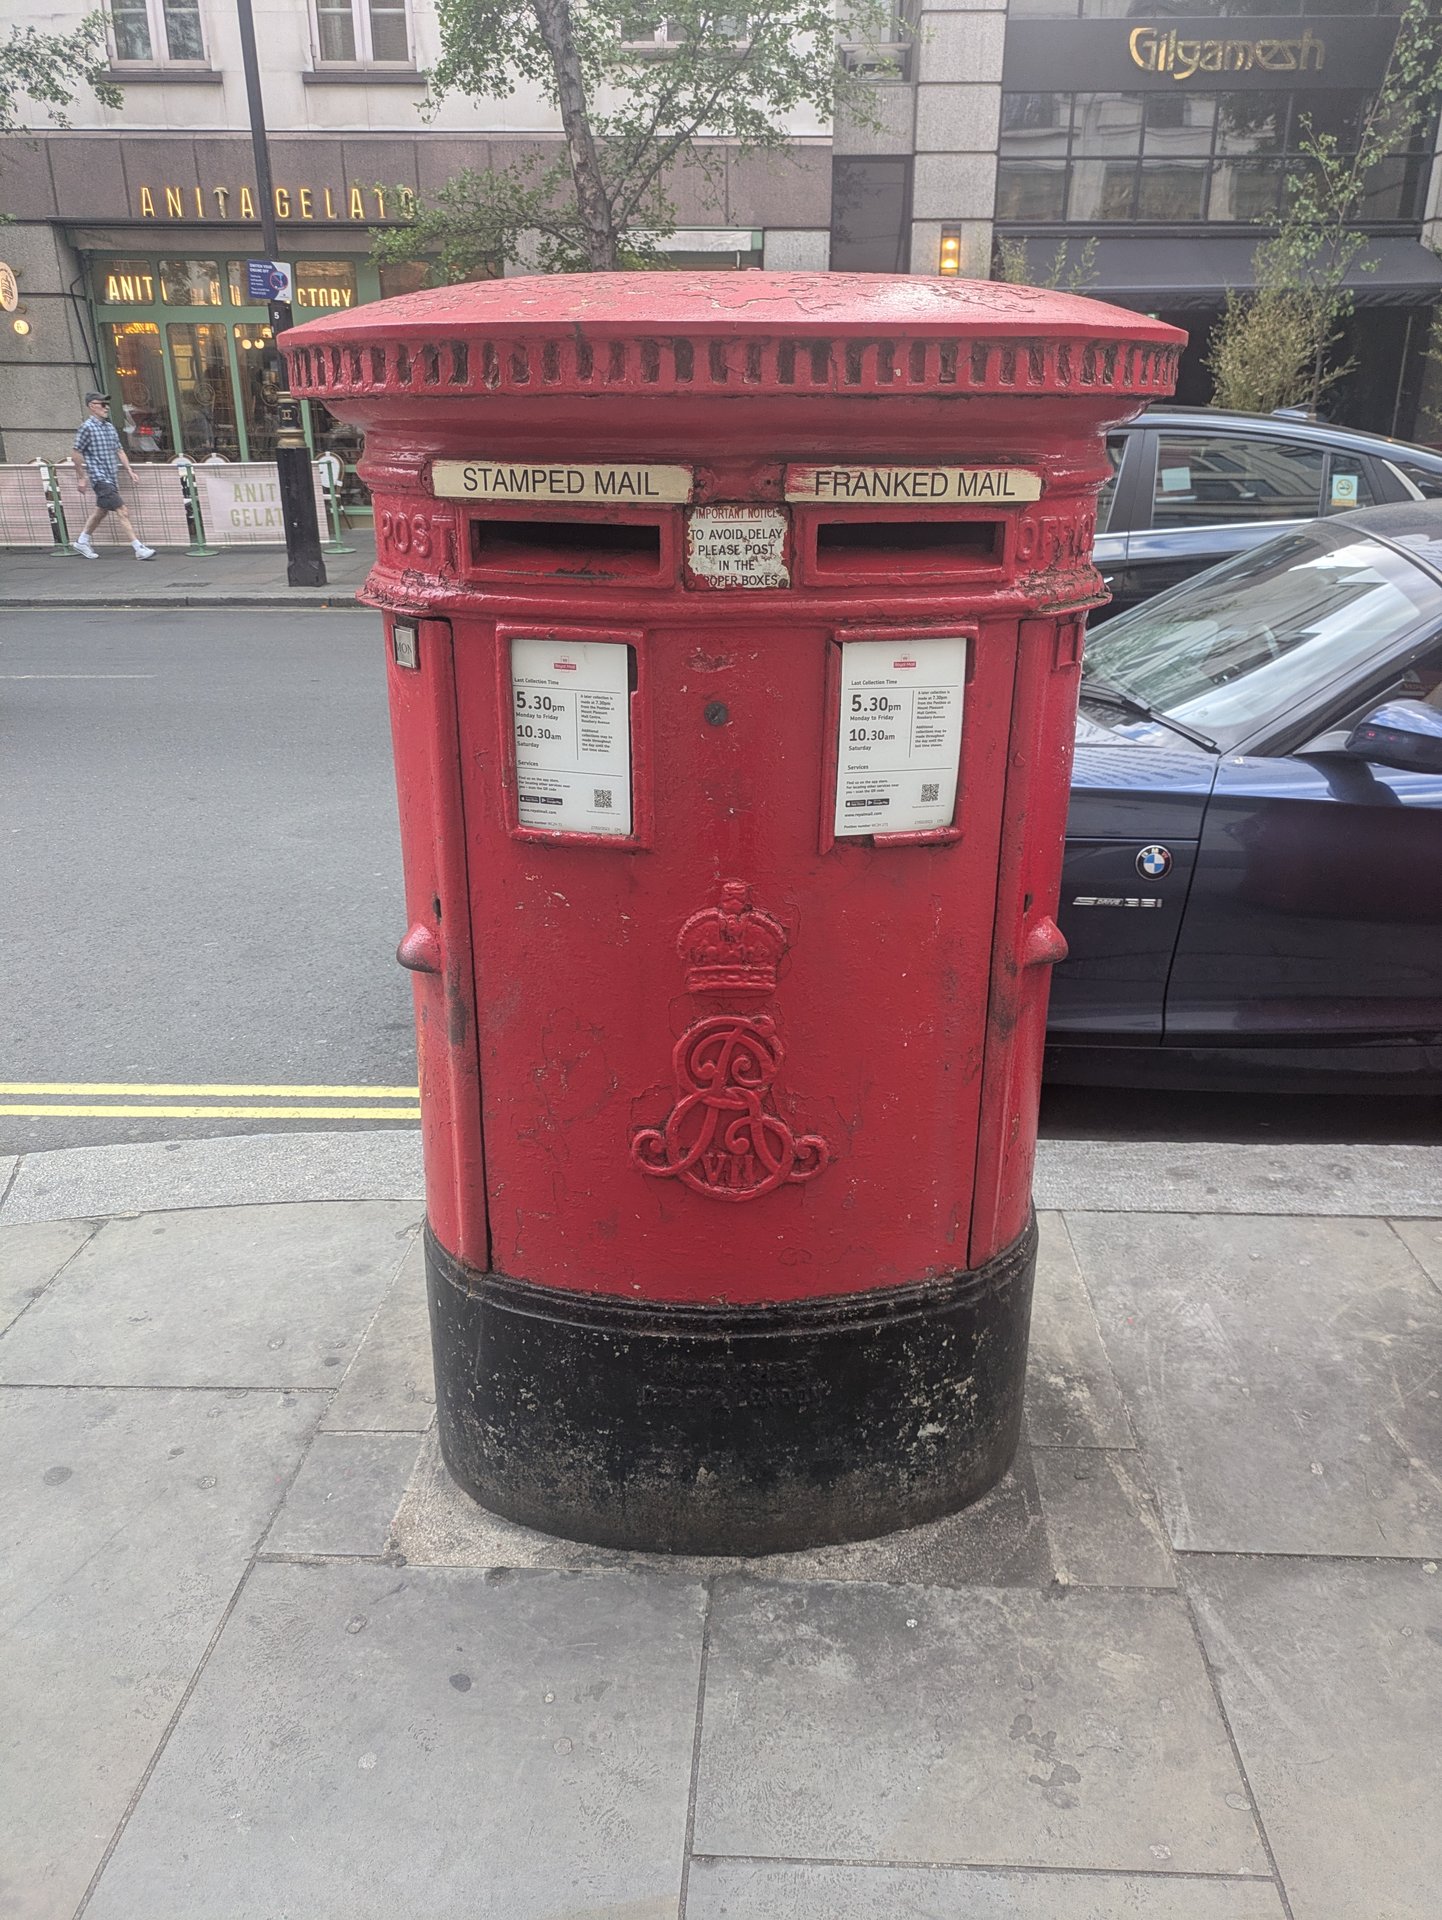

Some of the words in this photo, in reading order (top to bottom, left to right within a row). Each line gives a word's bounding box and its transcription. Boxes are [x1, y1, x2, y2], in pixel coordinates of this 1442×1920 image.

[1129, 26, 1325, 80] Gilgamesh
[141, 187, 255, 218] ANITA
[275, 187, 414, 219] GELATO
[463, 467, 585, 494] STAMPED
[594, 470, 660, 496] MAIL
[814, 471, 948, 496] FRANKED
[957, 472, 1016, 496] MAIL
[234, 483, 276, 502] ANIT
[230, 508, 283, 527] GELAT
[696, 508, 745, 519] IMPORTANT
[748, 508, 777, 518] NOTICE
[381, 510, 455, 566] POST
[690, 530, 704, 540] TO
[709, 529, 743, 540] AVOID
[748, 528, 783, 539] DELAY
[698, 545, 740, 555] PLEASE
[745, 544, 775, 554] POST
[719, 561, 729, 570] IN
[734, 560, 755, 570] THE
[704, 575, 738, 586] ROPER
[742, 575, 777, 586] BOXES
[516, 691, 565, 712] 5.30pm
[851, 694, 901, 712] 5.30pm
[517, 725, 561, 740] 10.30am
[850, 728, 895, 741] 10.30am
